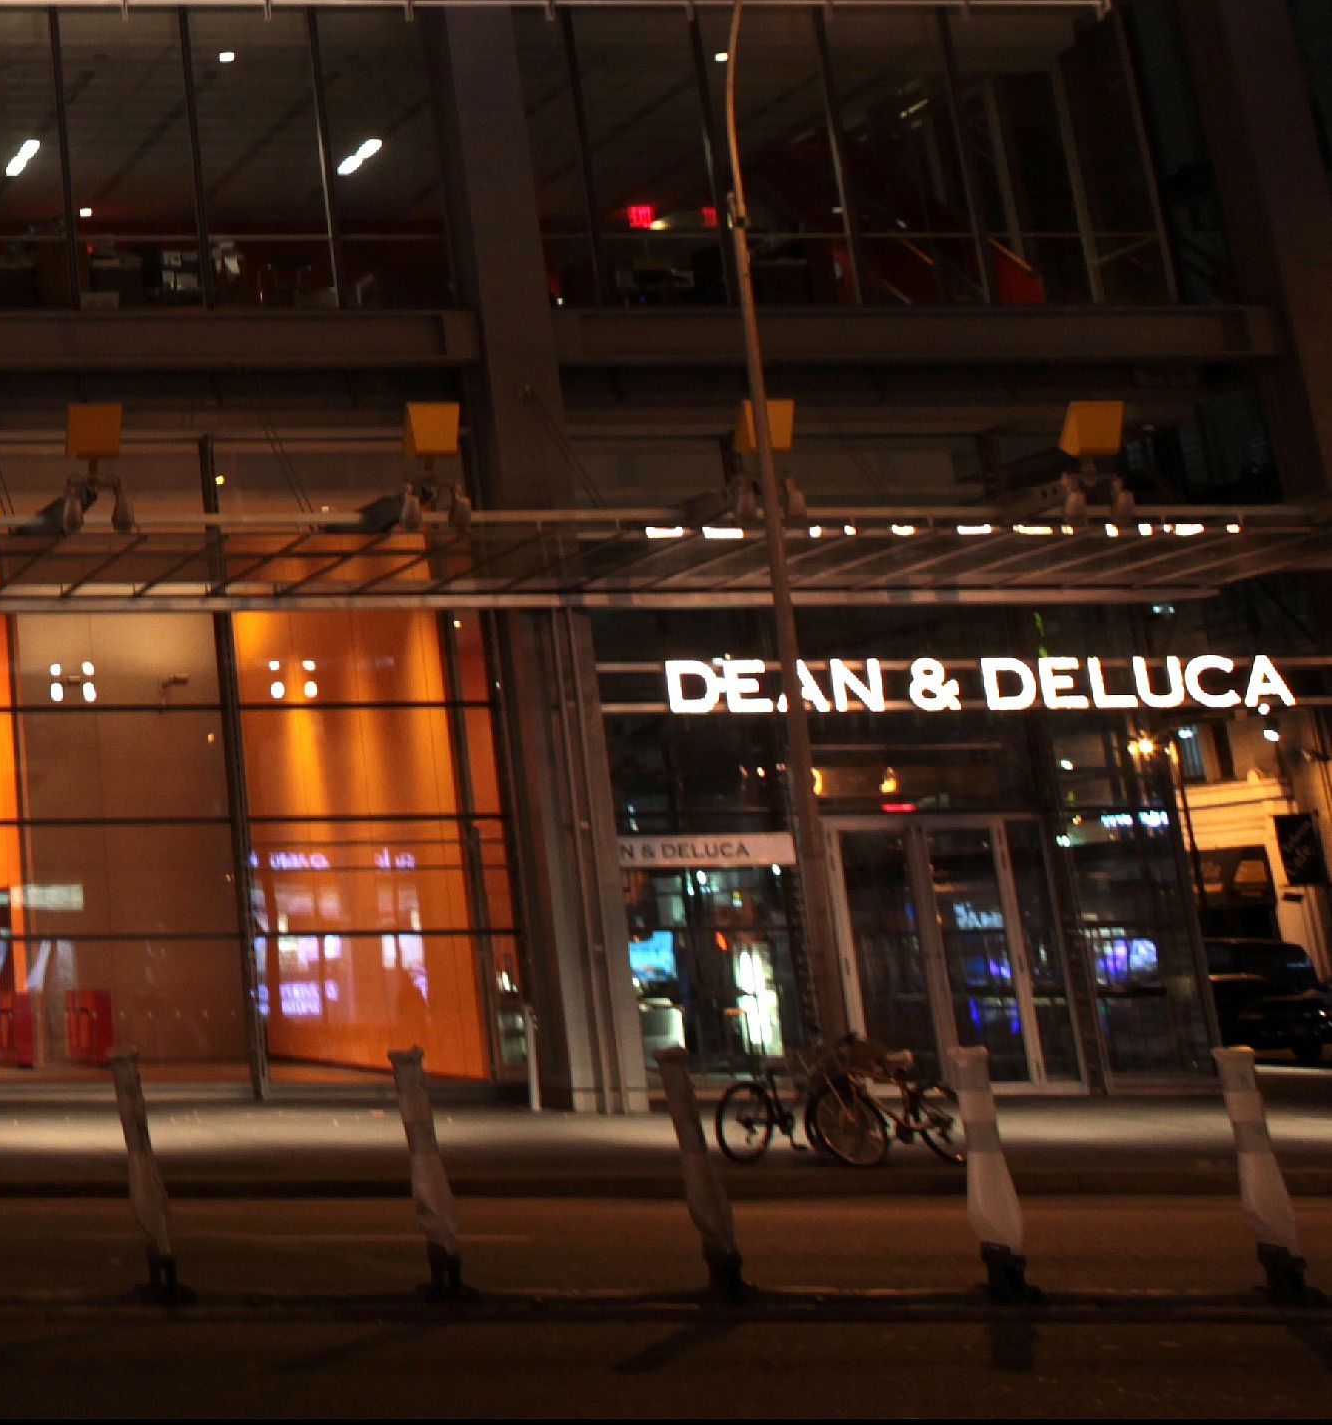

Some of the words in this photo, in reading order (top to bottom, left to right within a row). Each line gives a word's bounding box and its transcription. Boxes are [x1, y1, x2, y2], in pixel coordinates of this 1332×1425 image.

[909, 658, 961, 712] &
[981, 654, 1296, 710] DELUCA
[661, 840, 751, 859] DELUCA
